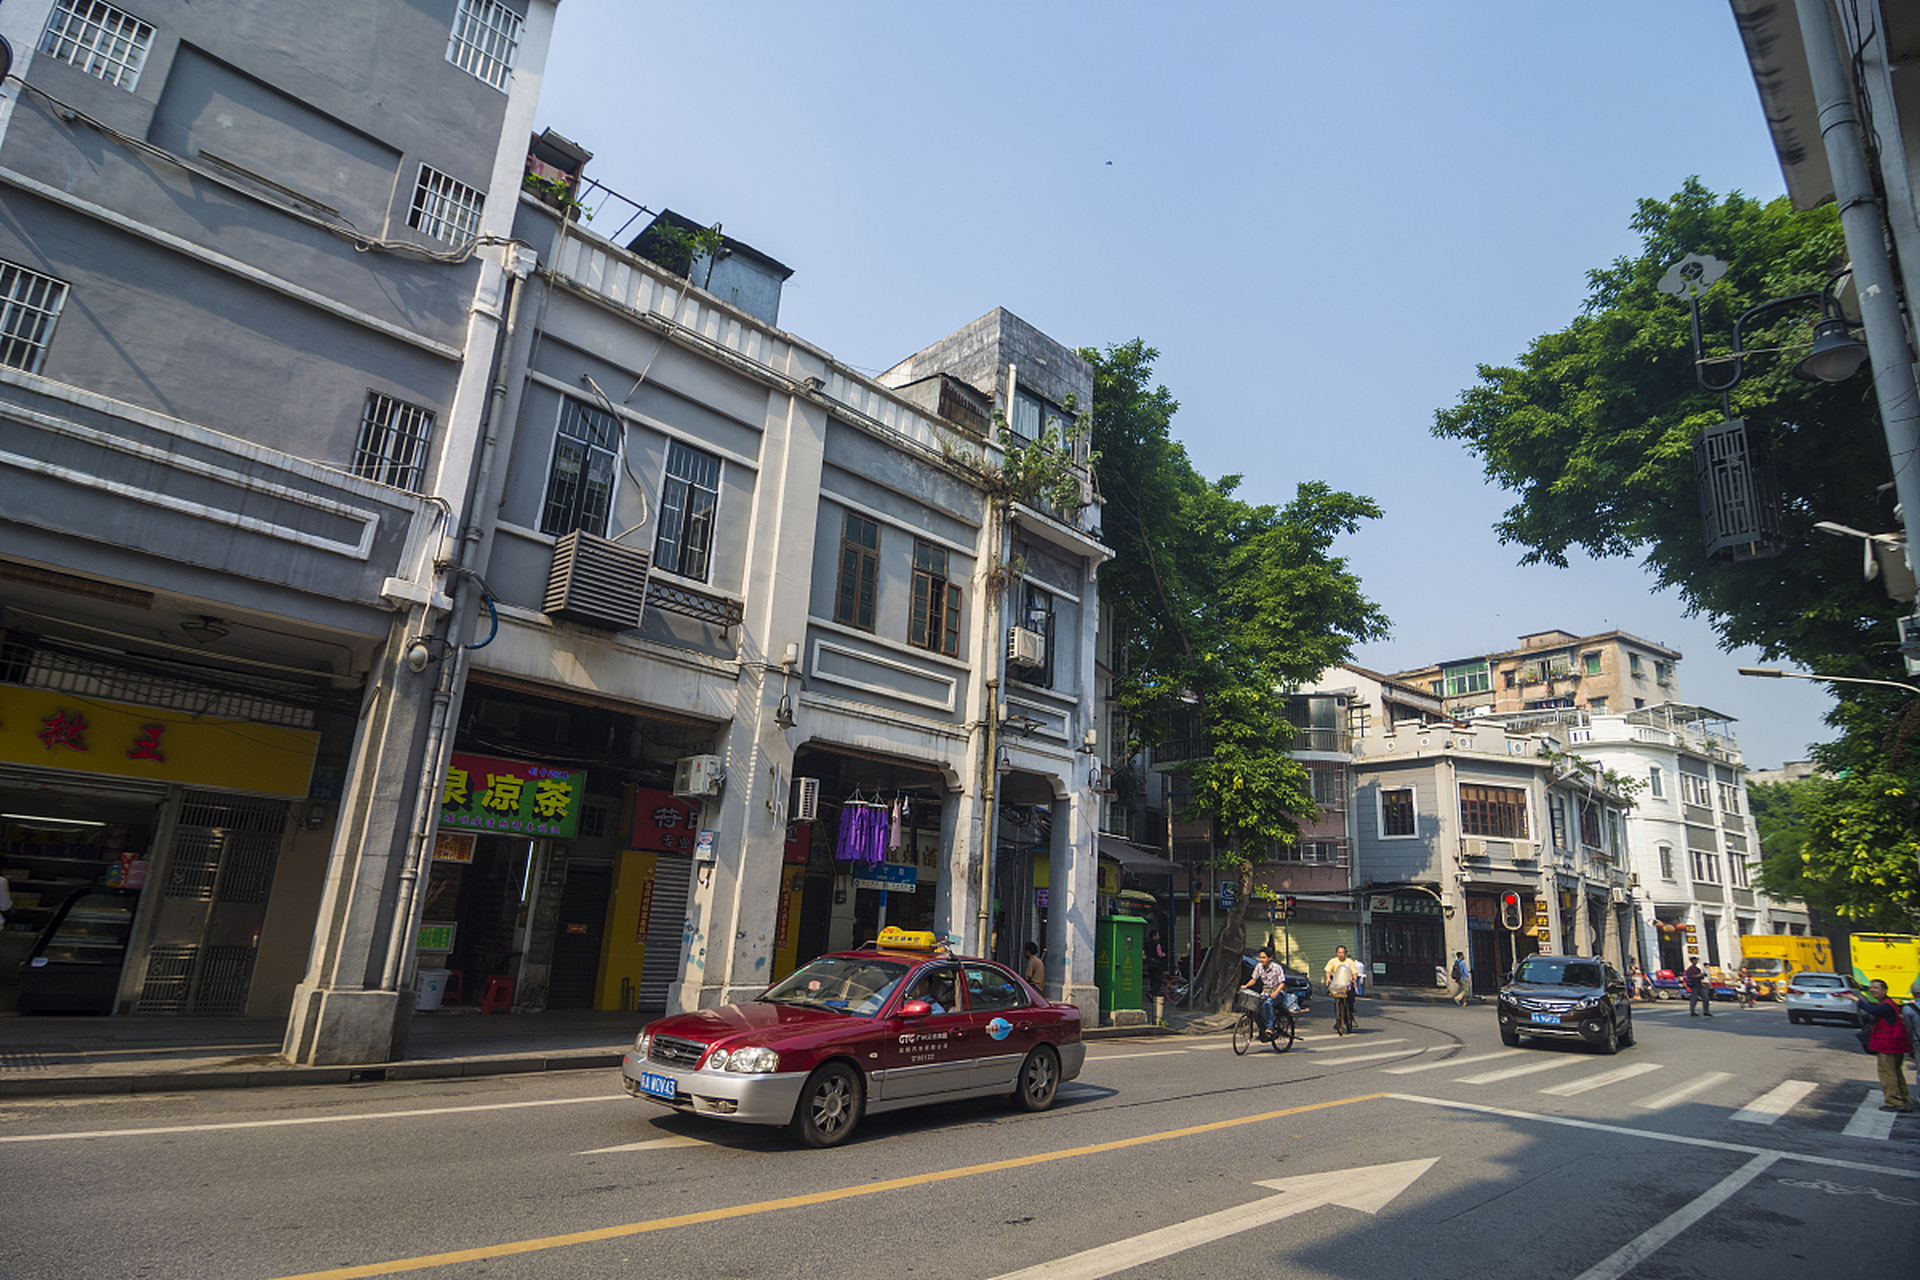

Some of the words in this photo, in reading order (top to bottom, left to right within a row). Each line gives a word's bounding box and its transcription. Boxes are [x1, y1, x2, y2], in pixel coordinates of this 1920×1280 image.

[442, 765, 573, 818] 泉凉茶
[662, 833, 691, 849] 专业
